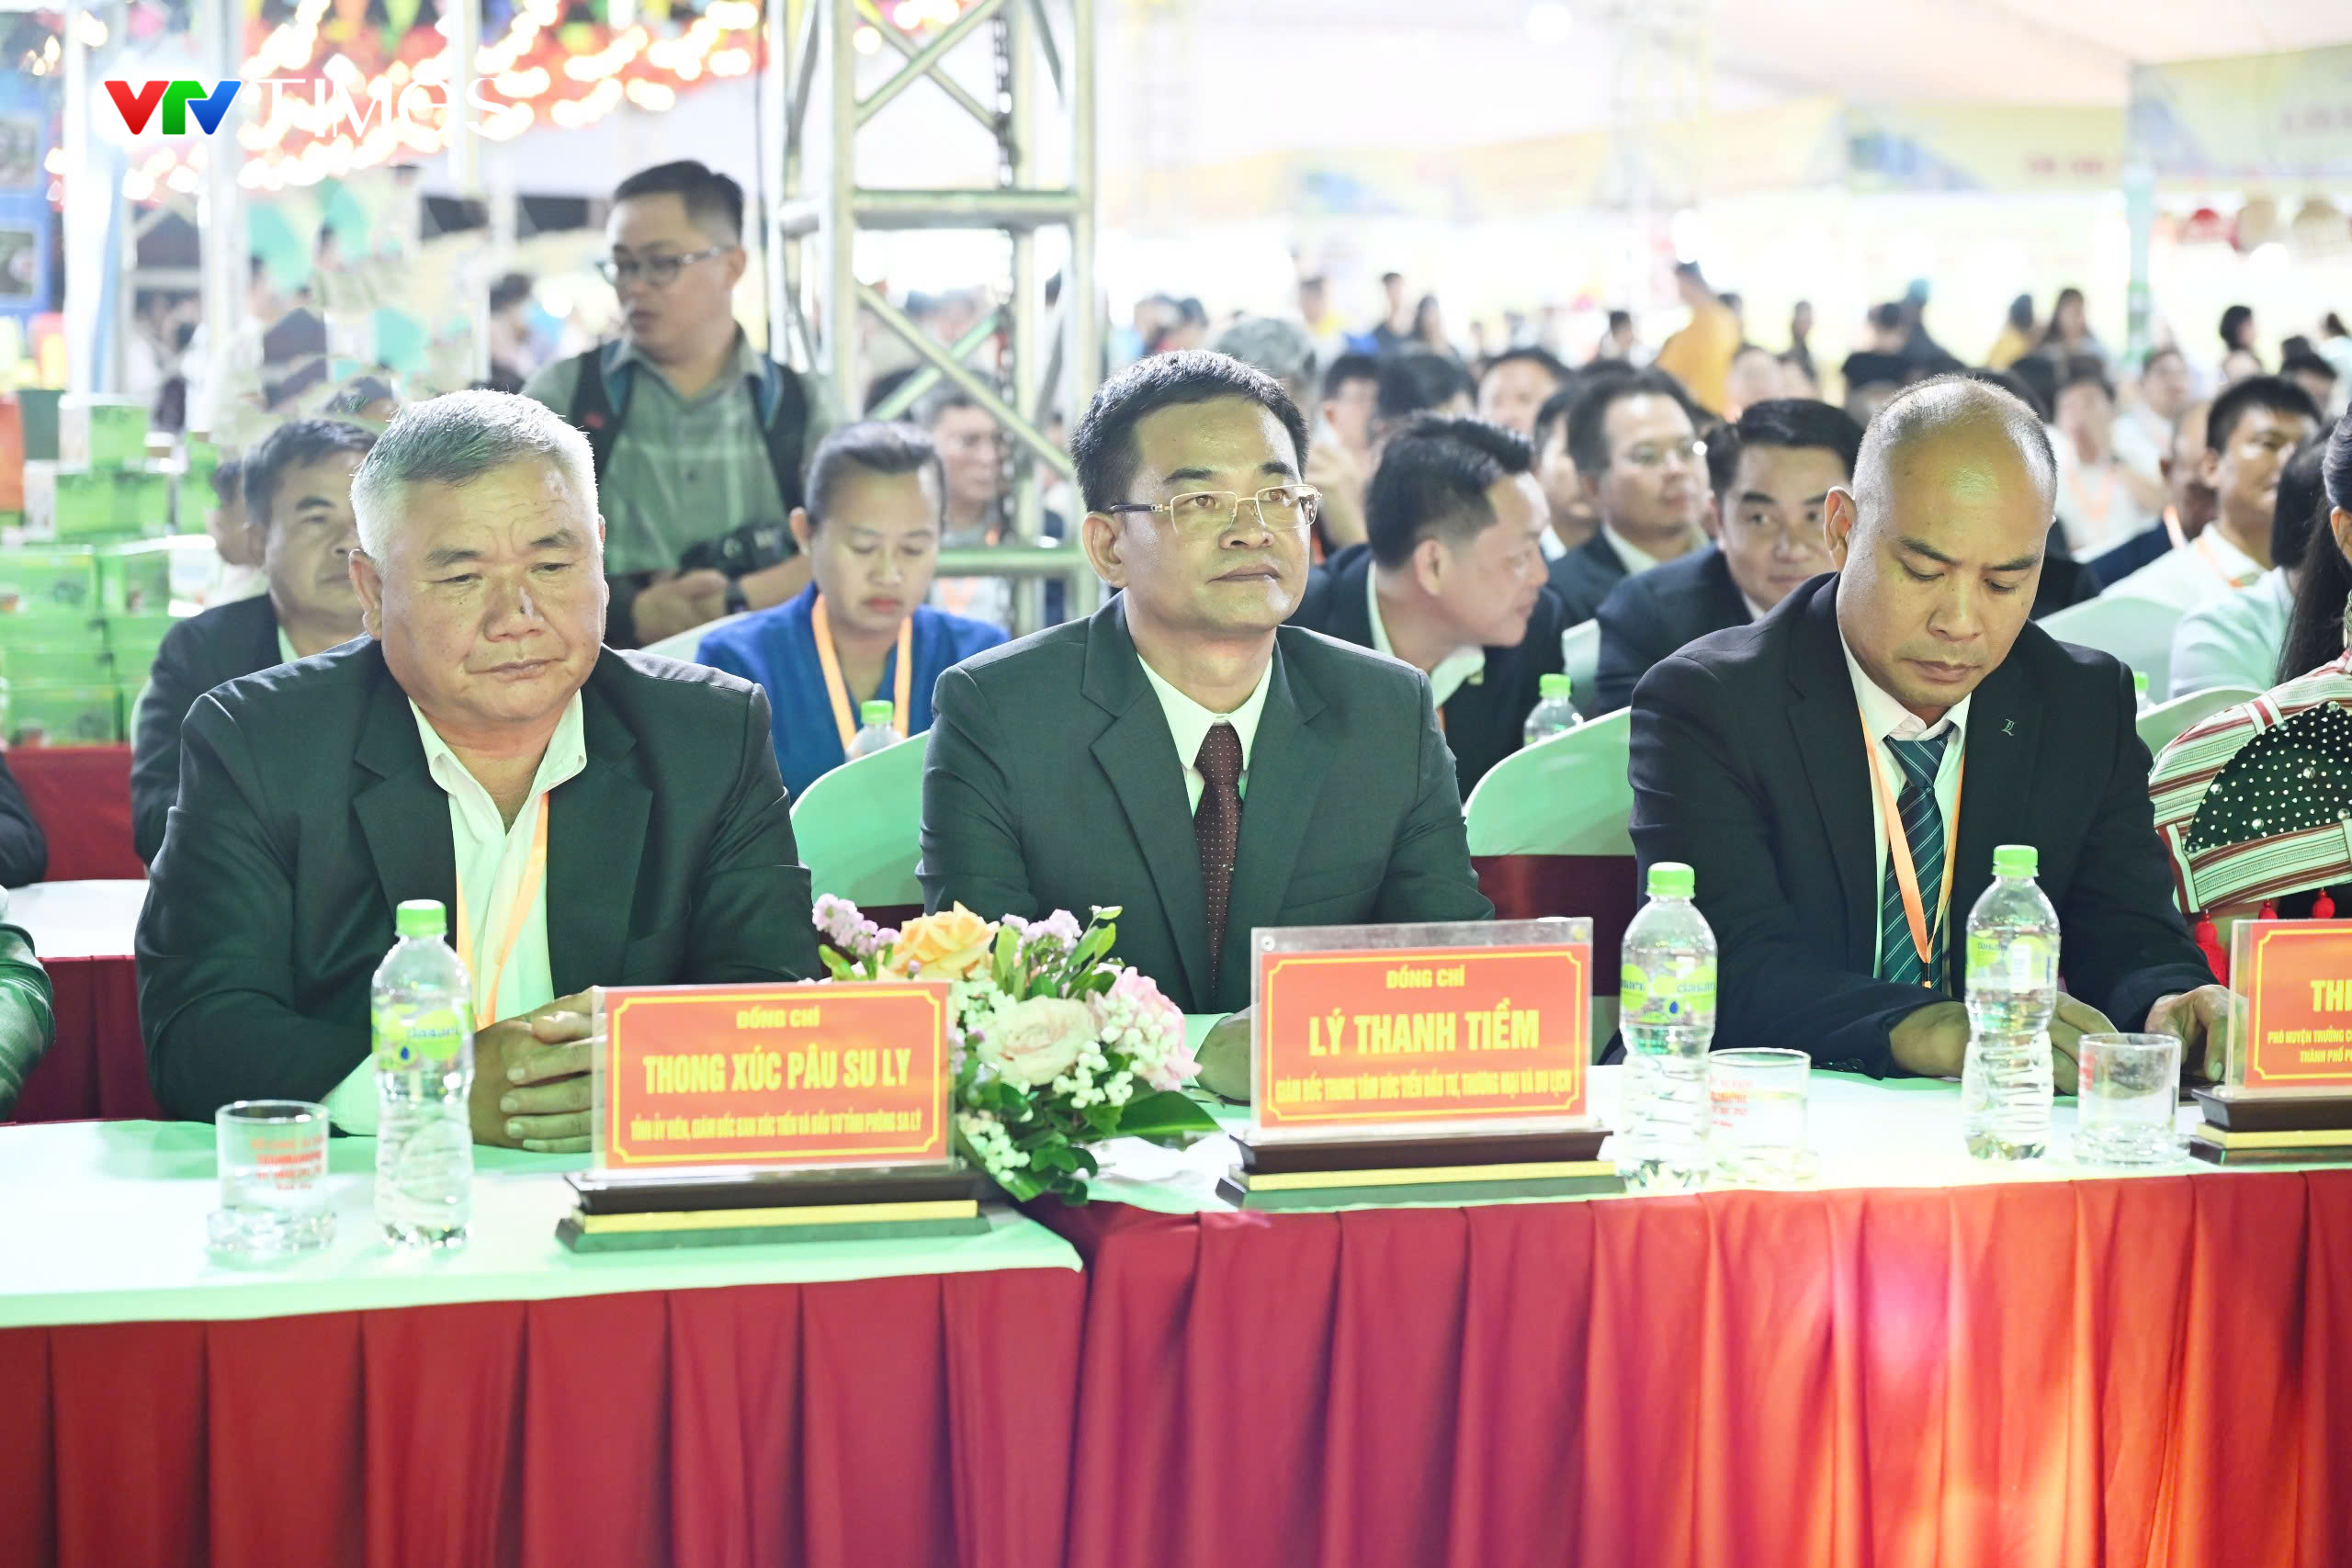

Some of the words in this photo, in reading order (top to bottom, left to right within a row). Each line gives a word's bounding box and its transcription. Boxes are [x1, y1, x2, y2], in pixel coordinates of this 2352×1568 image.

[1308, 1007, 1346, 1056] LÝ
[1353, 1012, 1457, 1055] THANH
[642, 1054, 726, 1094] THONG
[731, 1045, 782, 1091] XÚC
[786, 1043, 838, 1090] PÂU
[842, 1048, 876, 1088] SU
[882, 1048, 911, 1087] LY
